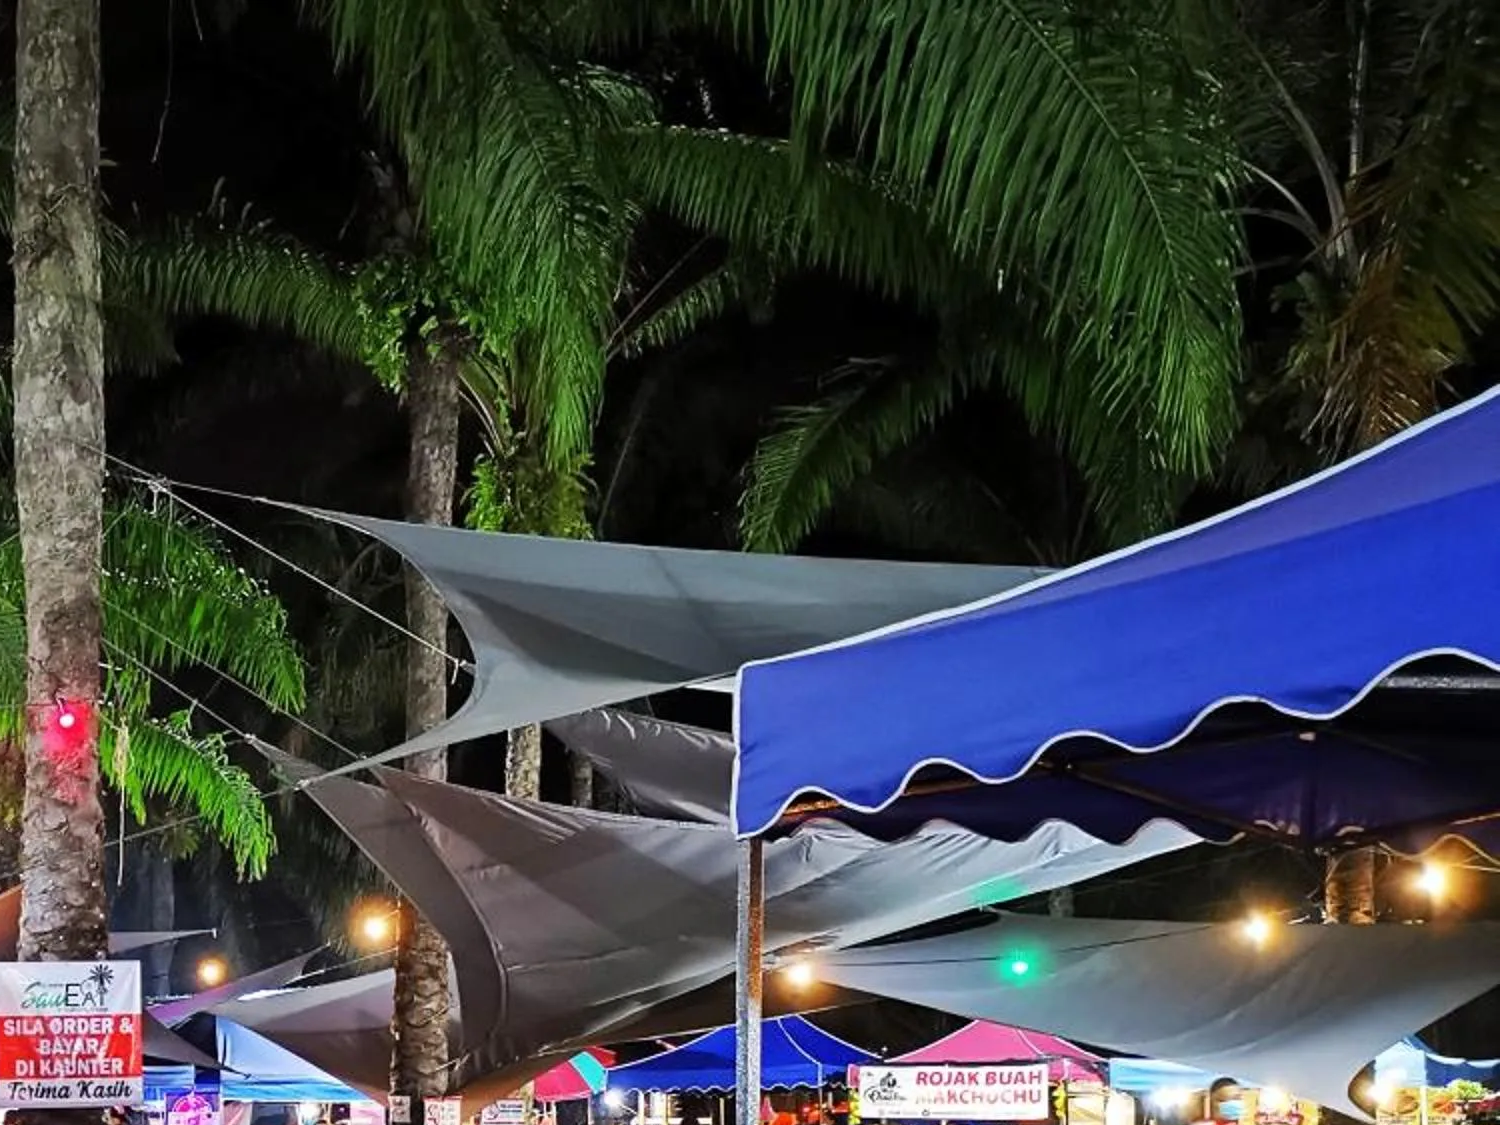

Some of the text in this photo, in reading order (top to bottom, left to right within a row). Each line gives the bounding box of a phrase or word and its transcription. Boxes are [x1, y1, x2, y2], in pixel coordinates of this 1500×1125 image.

[3, 1017, 134, 1036] SILA ORDER &
[39, 1037, 98, 1056] BAYAR
[15, 1058, 124, 1077] DI KAUNTER
[915, 1070, 1043, 1087] ROJAK BUAH
[8, 1079, 133, 1101] Terima Kasih
